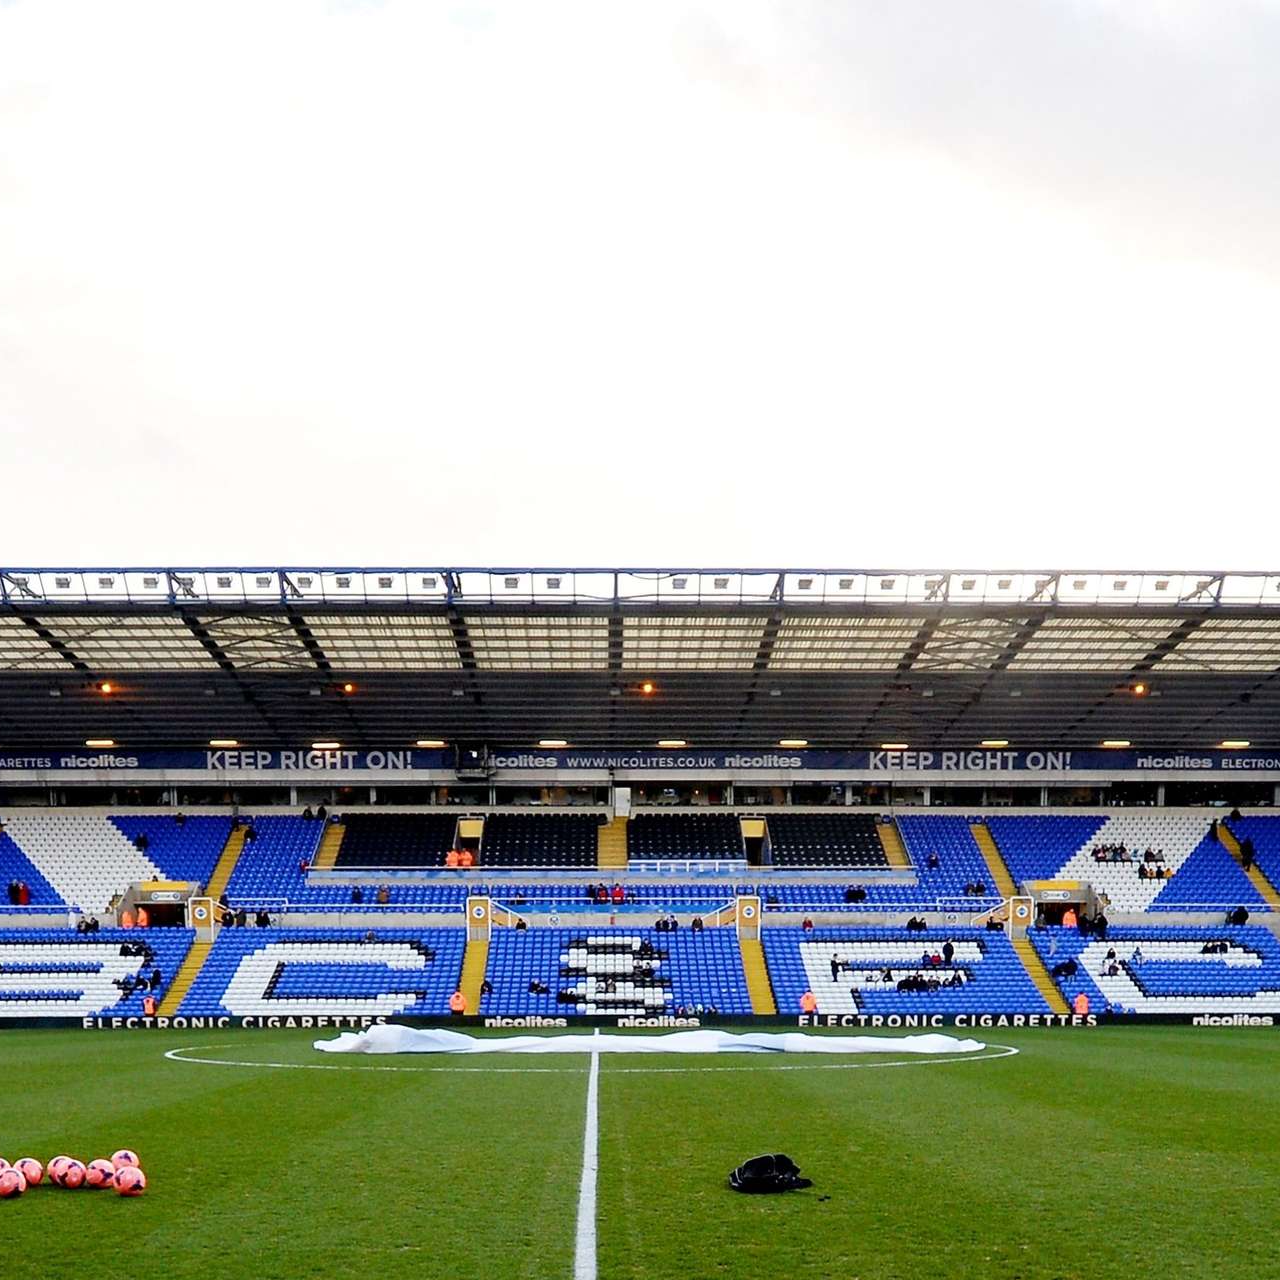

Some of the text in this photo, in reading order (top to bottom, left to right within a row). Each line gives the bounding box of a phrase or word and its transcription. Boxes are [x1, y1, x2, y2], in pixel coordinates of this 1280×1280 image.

[60, 755, 138, 768] nicolites
[207, 751, 412, 770] KEEP RIGHT ON!
[566, 757, 716, 768] WWW.NICOLITES.CO.UK
[724, 754, 802, 768] nicolites
[869, 751, 1072, 771] KEEP RIGHT ON!
[1136, 755, 1213, 769] nicolites
[82, 1015, 387, 1029] ELECTRONIC CIGARETTES
[484, 1015, 568, 1028] nicolites
[617, 1014, 701, 1027] nicolites
[798, 1014, 1098, 1027] ELECTRONIC CIGARETTES
[1192, 1013, 1274, 1027] nicolites
